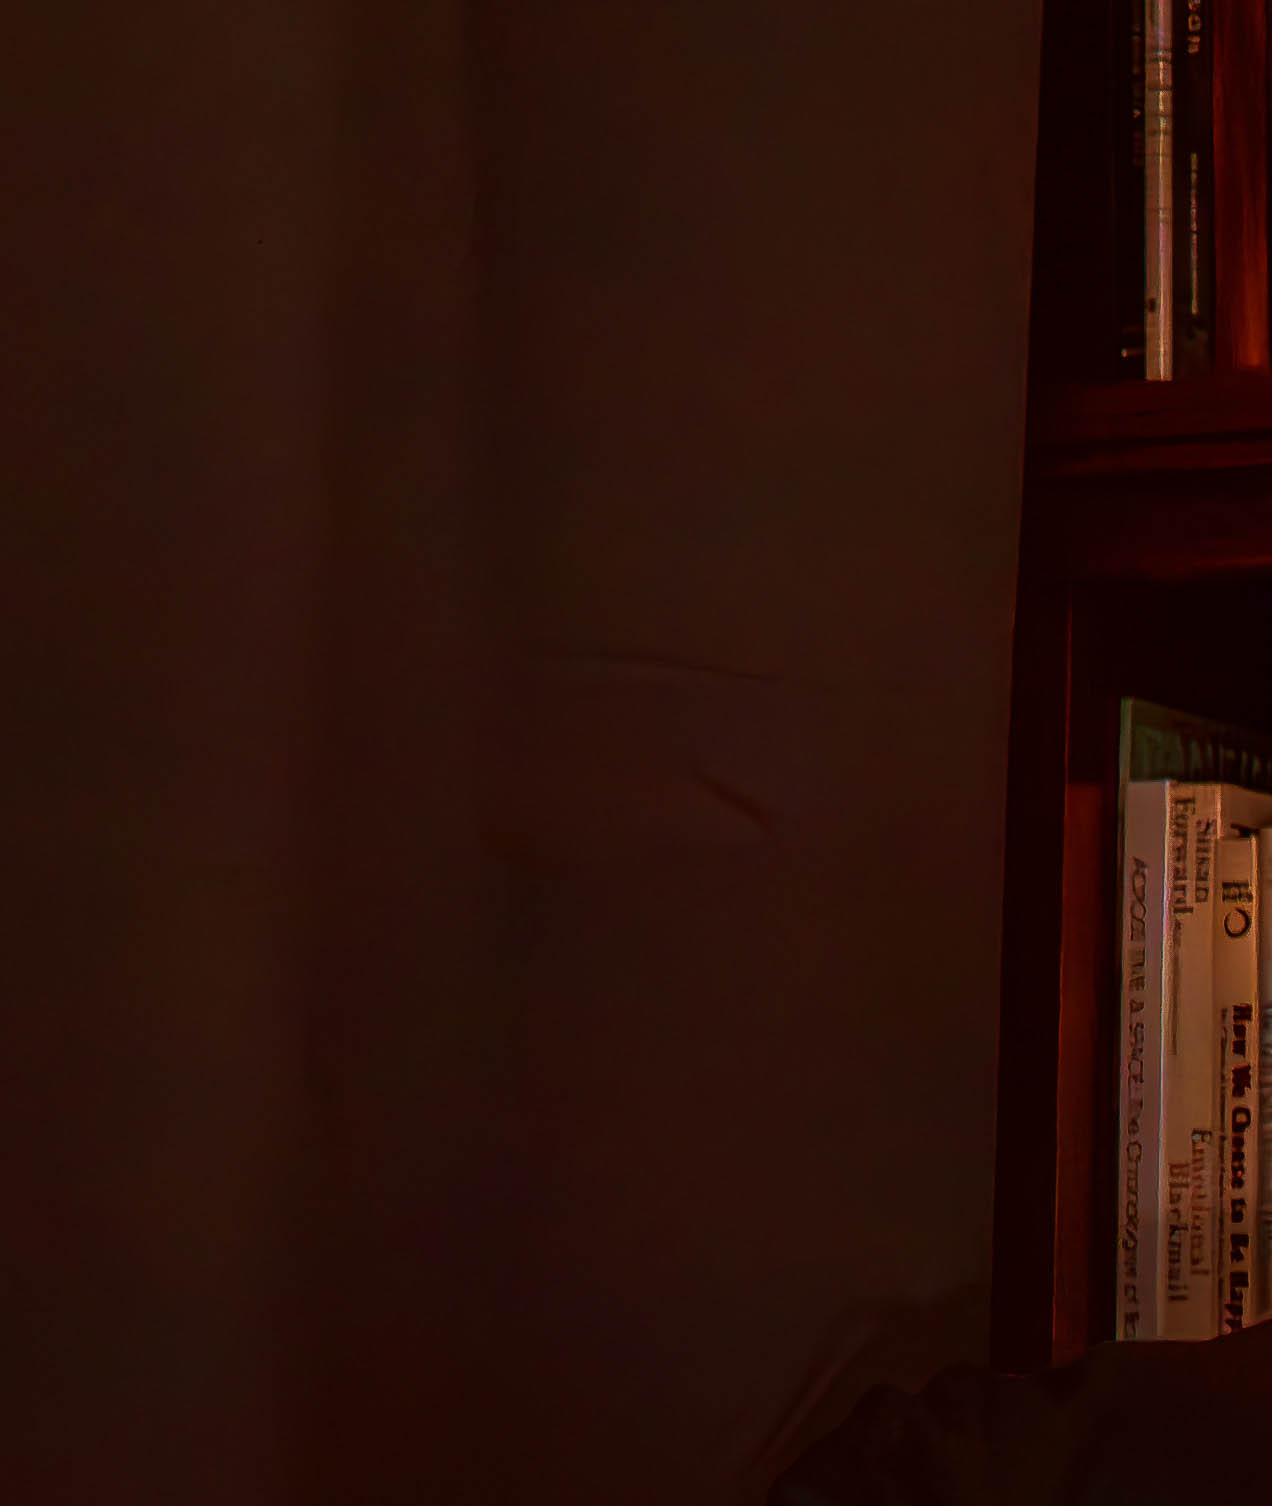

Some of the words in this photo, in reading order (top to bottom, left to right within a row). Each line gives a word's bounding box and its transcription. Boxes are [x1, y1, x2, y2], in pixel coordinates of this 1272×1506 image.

[1170, 797, 1197, 915] Forward
[1194, 818, 1217, 904] Susan
[1231, 1004, 1253, 1057] How
[1230, 1066, 1253, 1097] We
[1165, 1161, 1191, 1303] Blackmail
[1189, 1127, 1213, 1277] Emotional
[1229, 1232, 1248, 1261] Be
[1225, 1271, 1248, 1334] Happ
